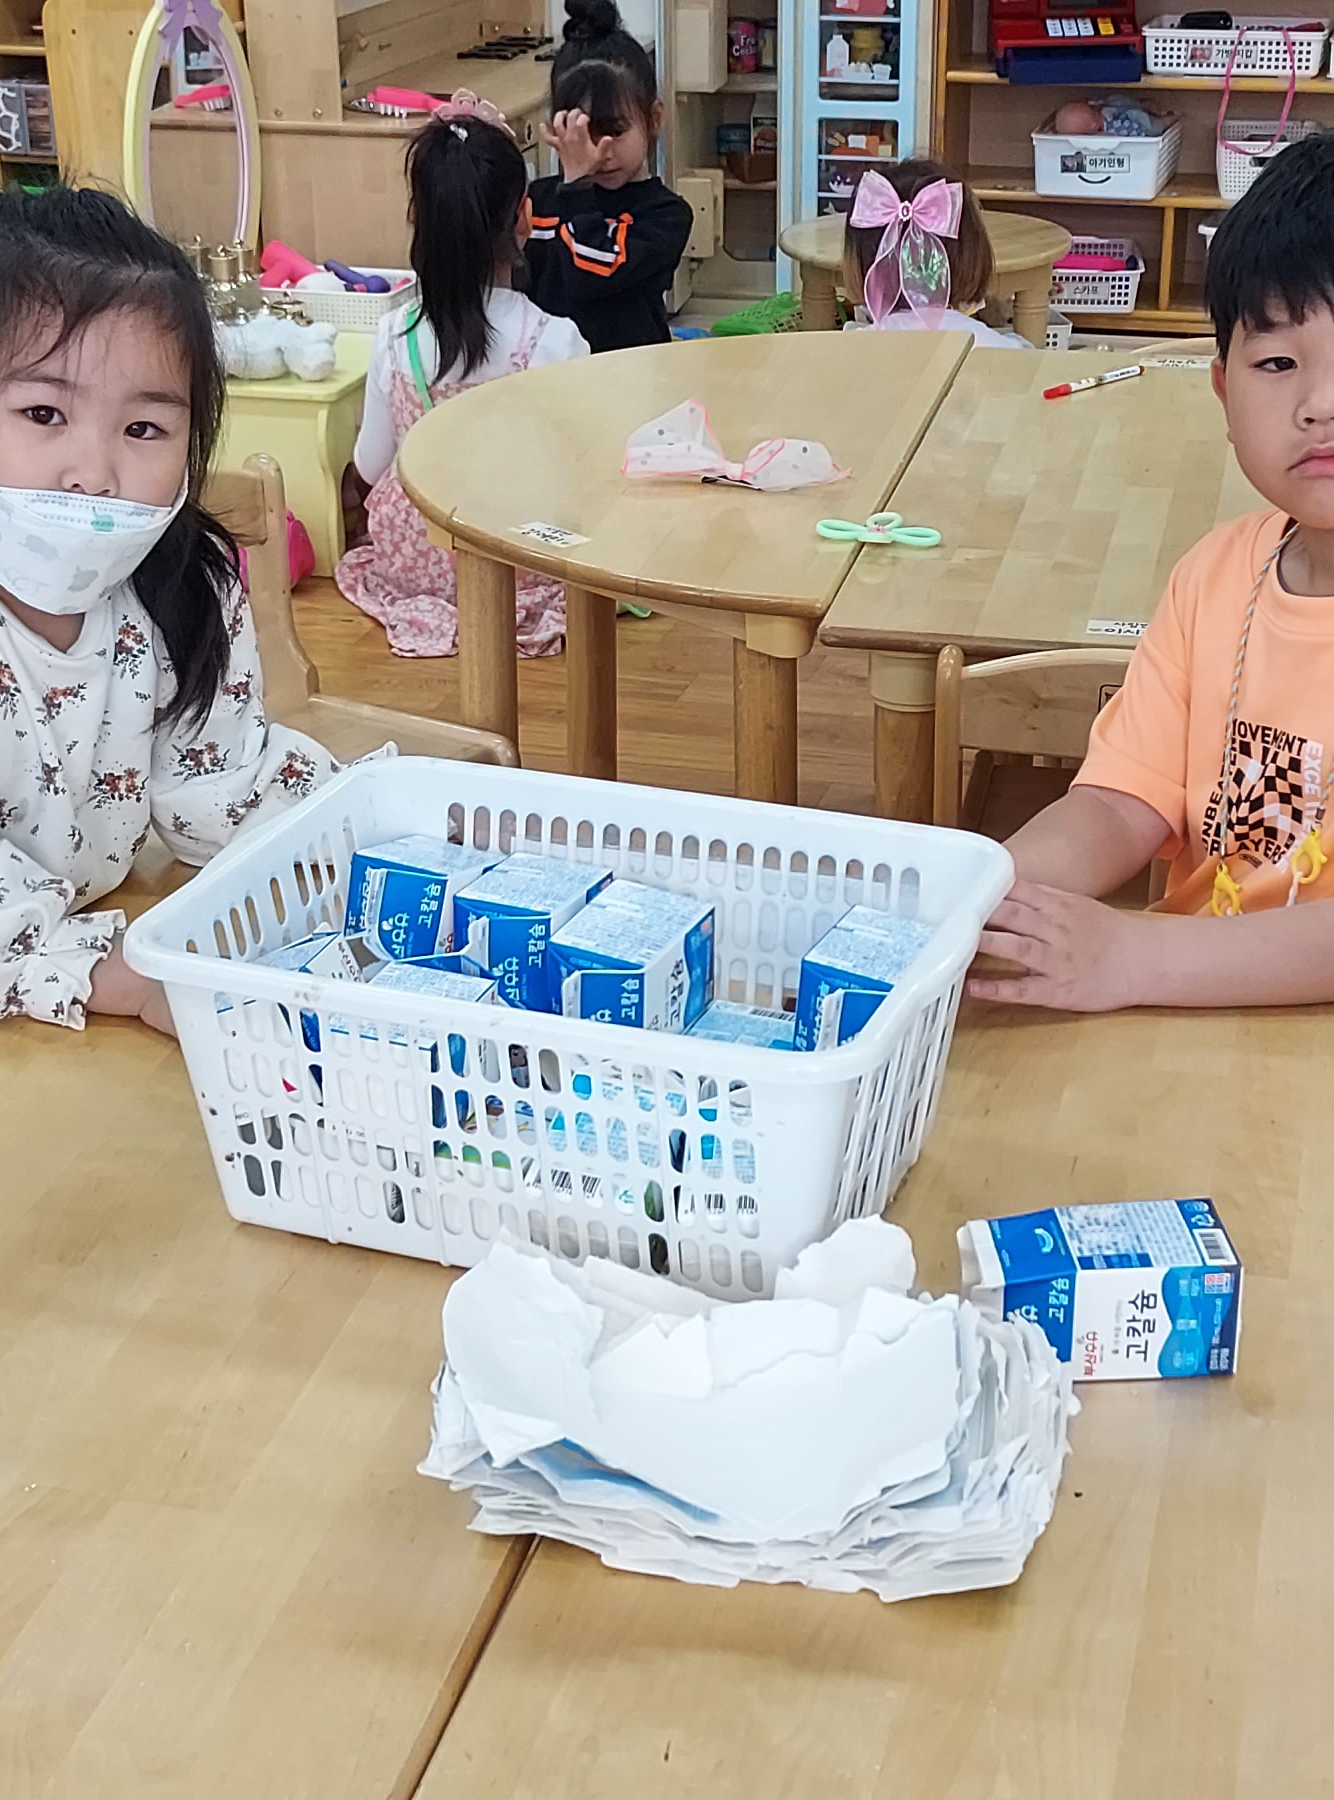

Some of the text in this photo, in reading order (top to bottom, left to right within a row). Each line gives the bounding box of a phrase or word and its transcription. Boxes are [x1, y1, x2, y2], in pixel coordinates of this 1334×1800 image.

[1237, 48, 1253, 59] 지갑
[1088, 157, 1125, 168] 아기인형
[1072, 285, 1099, 295] 스카프
[417, 881, 443, 929] 고칼슘
[528, 923, 546, 968] 고칼슘
[621, 977, 640, 1020] 고칼슘
[670, 958, 684, 1028] 고칼슘
[1048, 1277, 1070, 1324] 고칼슘
[1125, 1289, 1159, 1363] 고칼슘
[1082, 1330, 1099, 1376] 부산우유
